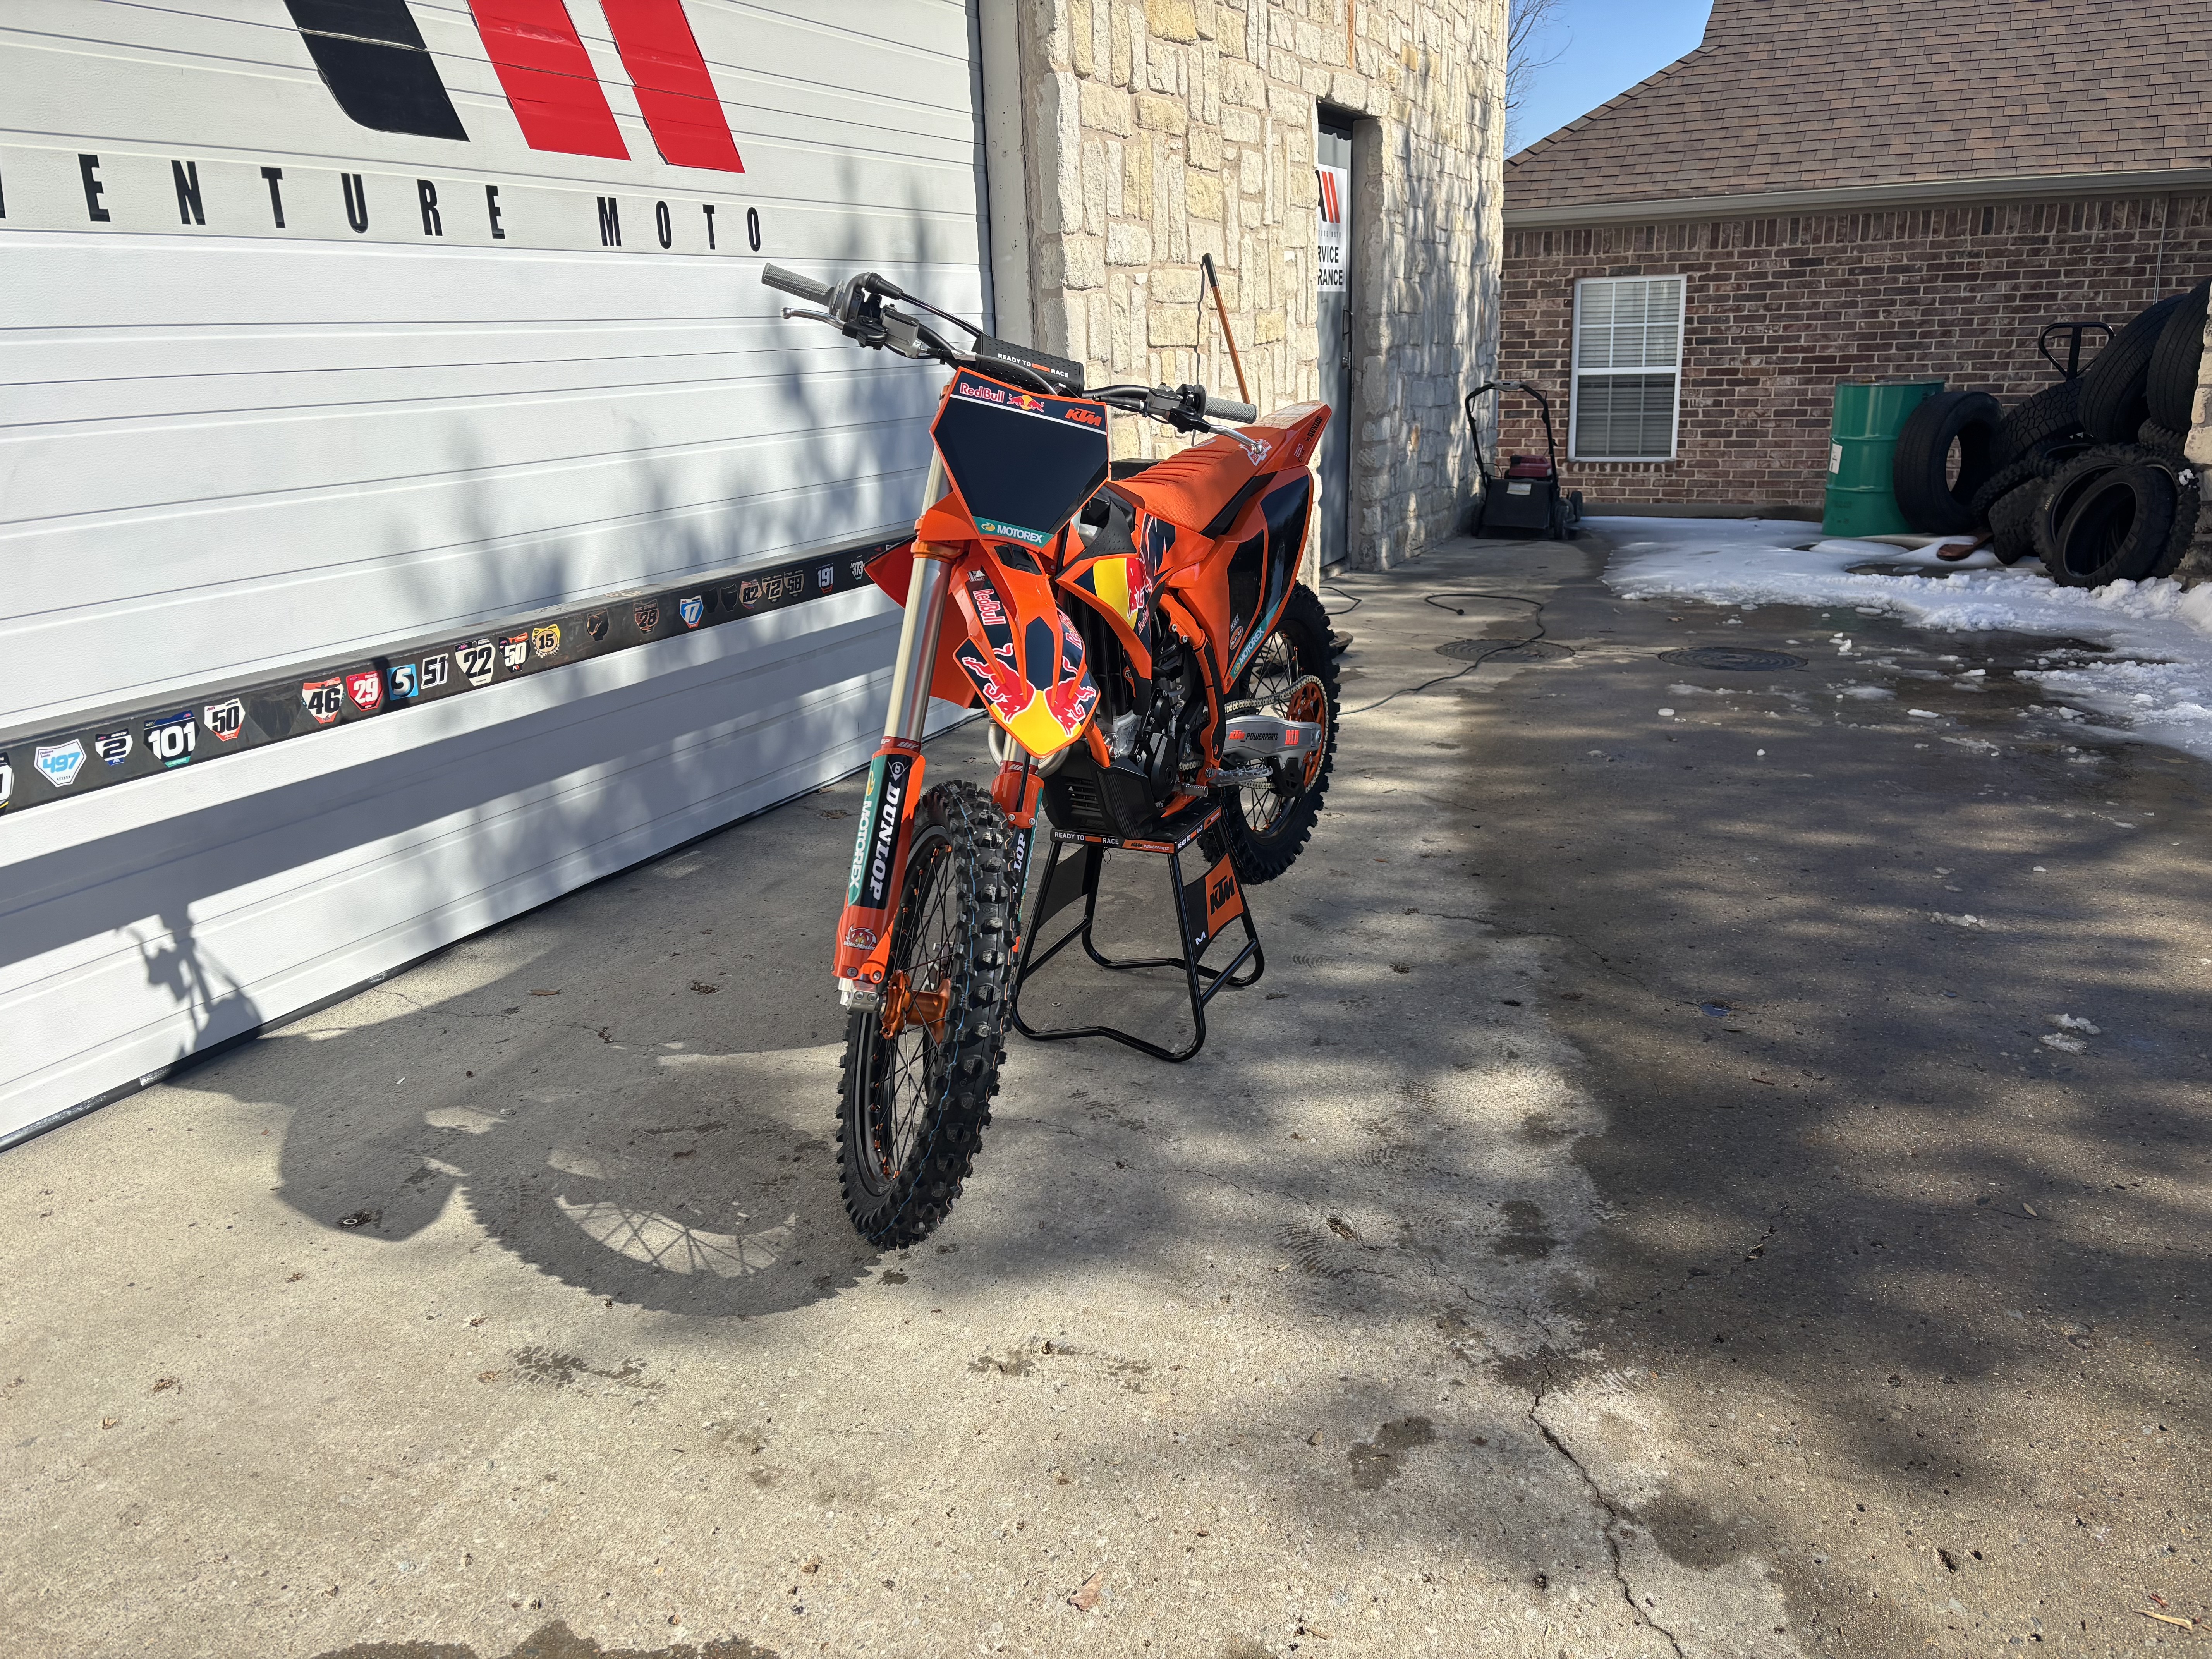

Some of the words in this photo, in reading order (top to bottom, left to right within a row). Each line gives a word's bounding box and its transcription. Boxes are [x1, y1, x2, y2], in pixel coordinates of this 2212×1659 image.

[0, 153, 506, 239] ENTURE
[596, 196, 762, 253] MOTO
[1317, 245, 1339, 263] RVICE
[1317, 269, 1343, 286] RANCE
[998, 353, 1021, 365] READY
[1051, 368, 1069, 378] RACE
[1065, 407, 1102, 426] KTM
[1307, 416, 1323, 438] DUNLOP
[997, 524, 1043, 544] MOTOREX
[787, 575, 802, 593] 58
[817, 566, 834, 588] 191
[743, 586, 759, 603] 82
[766, 580, 781, 598] 12
[639, 609, 657, 628] 28
[684, 602, 700, 622] 17
[539, 633, 554, 650] 15
[1239, 627, 1265, 665] MOTOREX
[464, 646, 492, 679] 22
[504, 642, 527, 667] 50
[393, 667, 412, 696] 5
[422, 654, 448, 688] 51
[308, 688, 341, 714] 46
[353, 677, 378, 704] 29
[212, 706, 239, 734] 50
[148, 721, 196, 759] 101
[1246, 733, 1278, 741] POWERPARTS
[103, 738, 127, 759] 2
[43, 752, 80, 773] 497
[849, 800, 872, 889] MOTOREX
[870, 781, 900, 900] DUNLOP
[1178, 838, 1186, 849] READY
[1210, 874, 1235, 915] KTM
